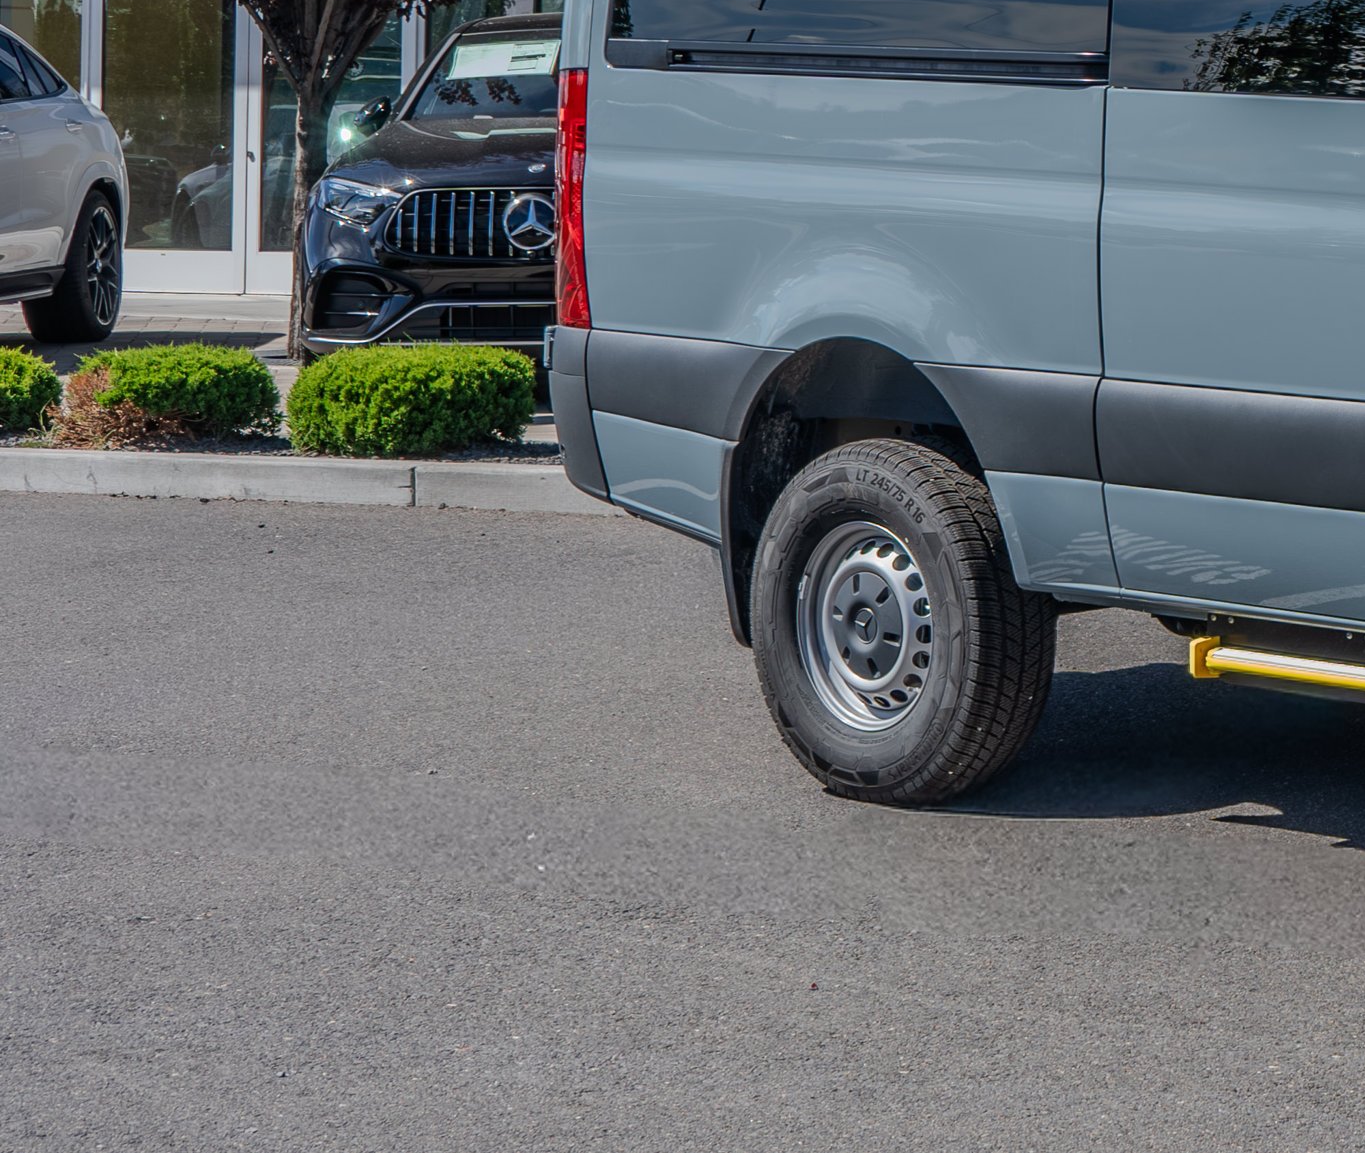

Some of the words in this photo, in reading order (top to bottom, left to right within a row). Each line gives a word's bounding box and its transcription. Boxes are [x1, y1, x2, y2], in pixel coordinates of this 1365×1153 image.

[856, 469, 870, 483] LT
[870, 473, 906, 503] 245/75
[904, 498, 915, 512] R
[912, 507, 926, 524] 16
